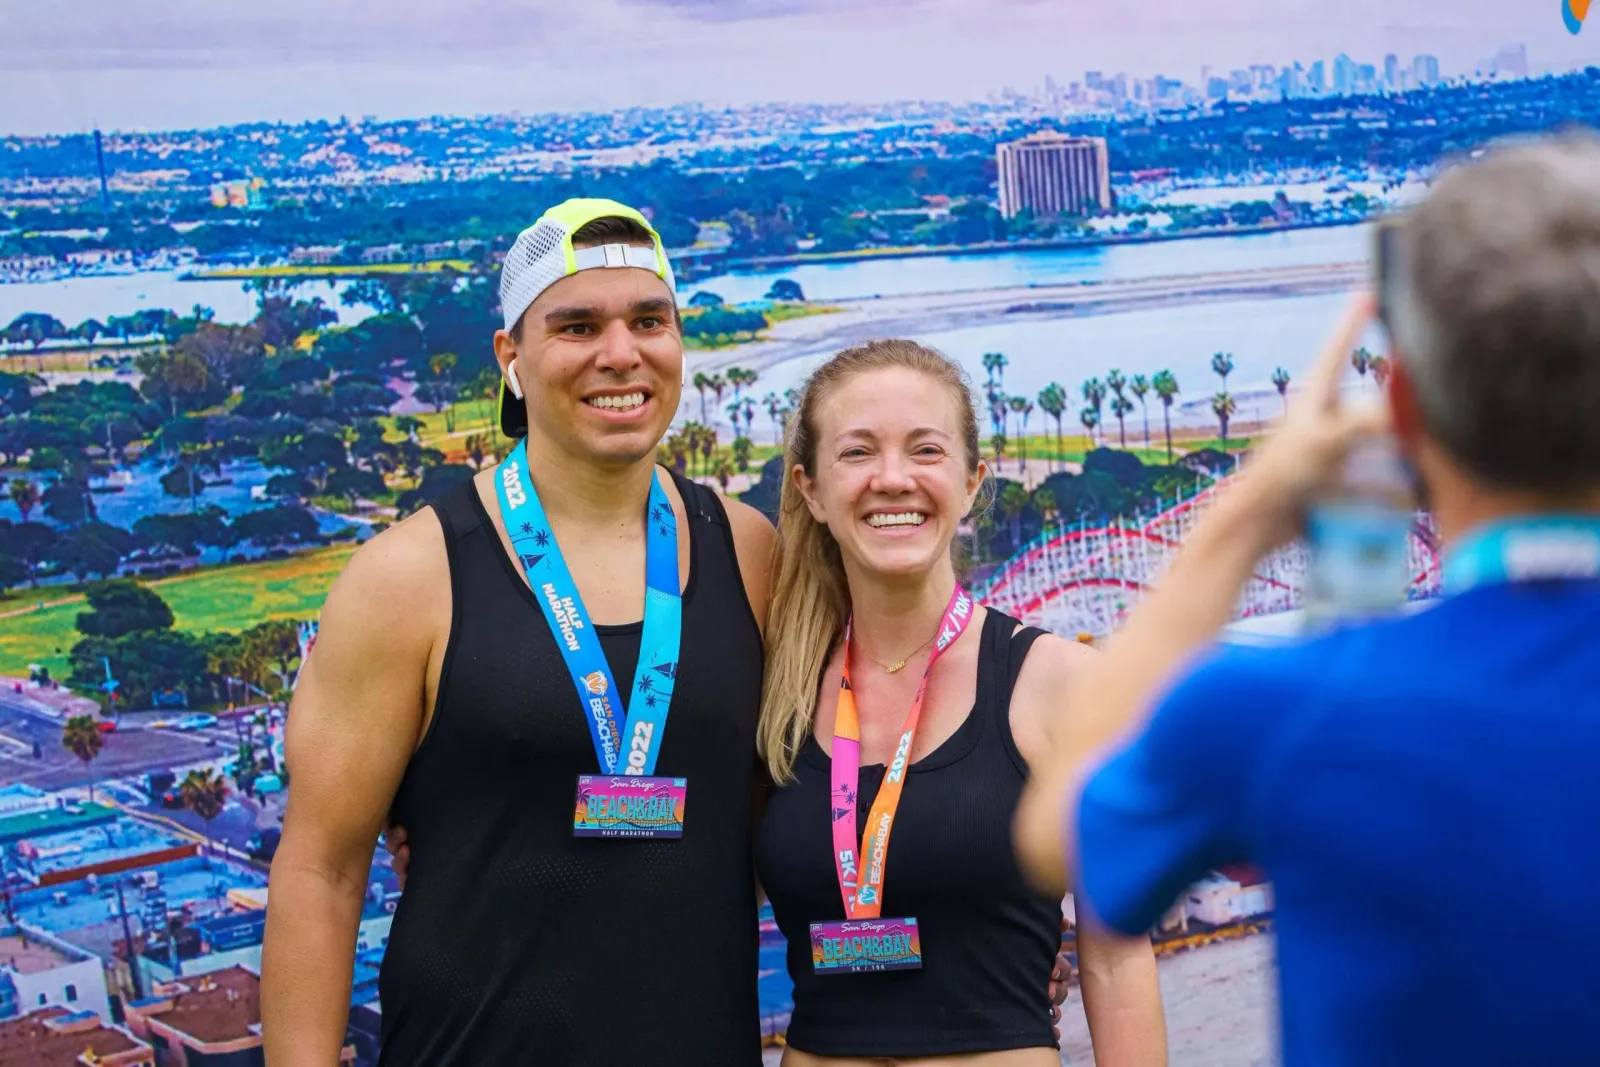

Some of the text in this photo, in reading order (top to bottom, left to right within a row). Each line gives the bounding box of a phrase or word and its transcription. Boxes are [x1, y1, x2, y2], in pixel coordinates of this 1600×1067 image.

[502, 461, 527, 510] 2022
[542, 583, 580, 651] MARATHON
[561, 597, 585, 629] HALF
[601, 696, 613, 718] SAN
[886, 730, 913, 784] 2022
[610, 777, 655, 792] San Diego
[586, 795, 678, 821] BEACH&BAY
[870, 812, 892, 884] BEACH&BAY
[841, 922, 886, 933] San Diego
[822, 933, 912, 960] BEACH&BAY
